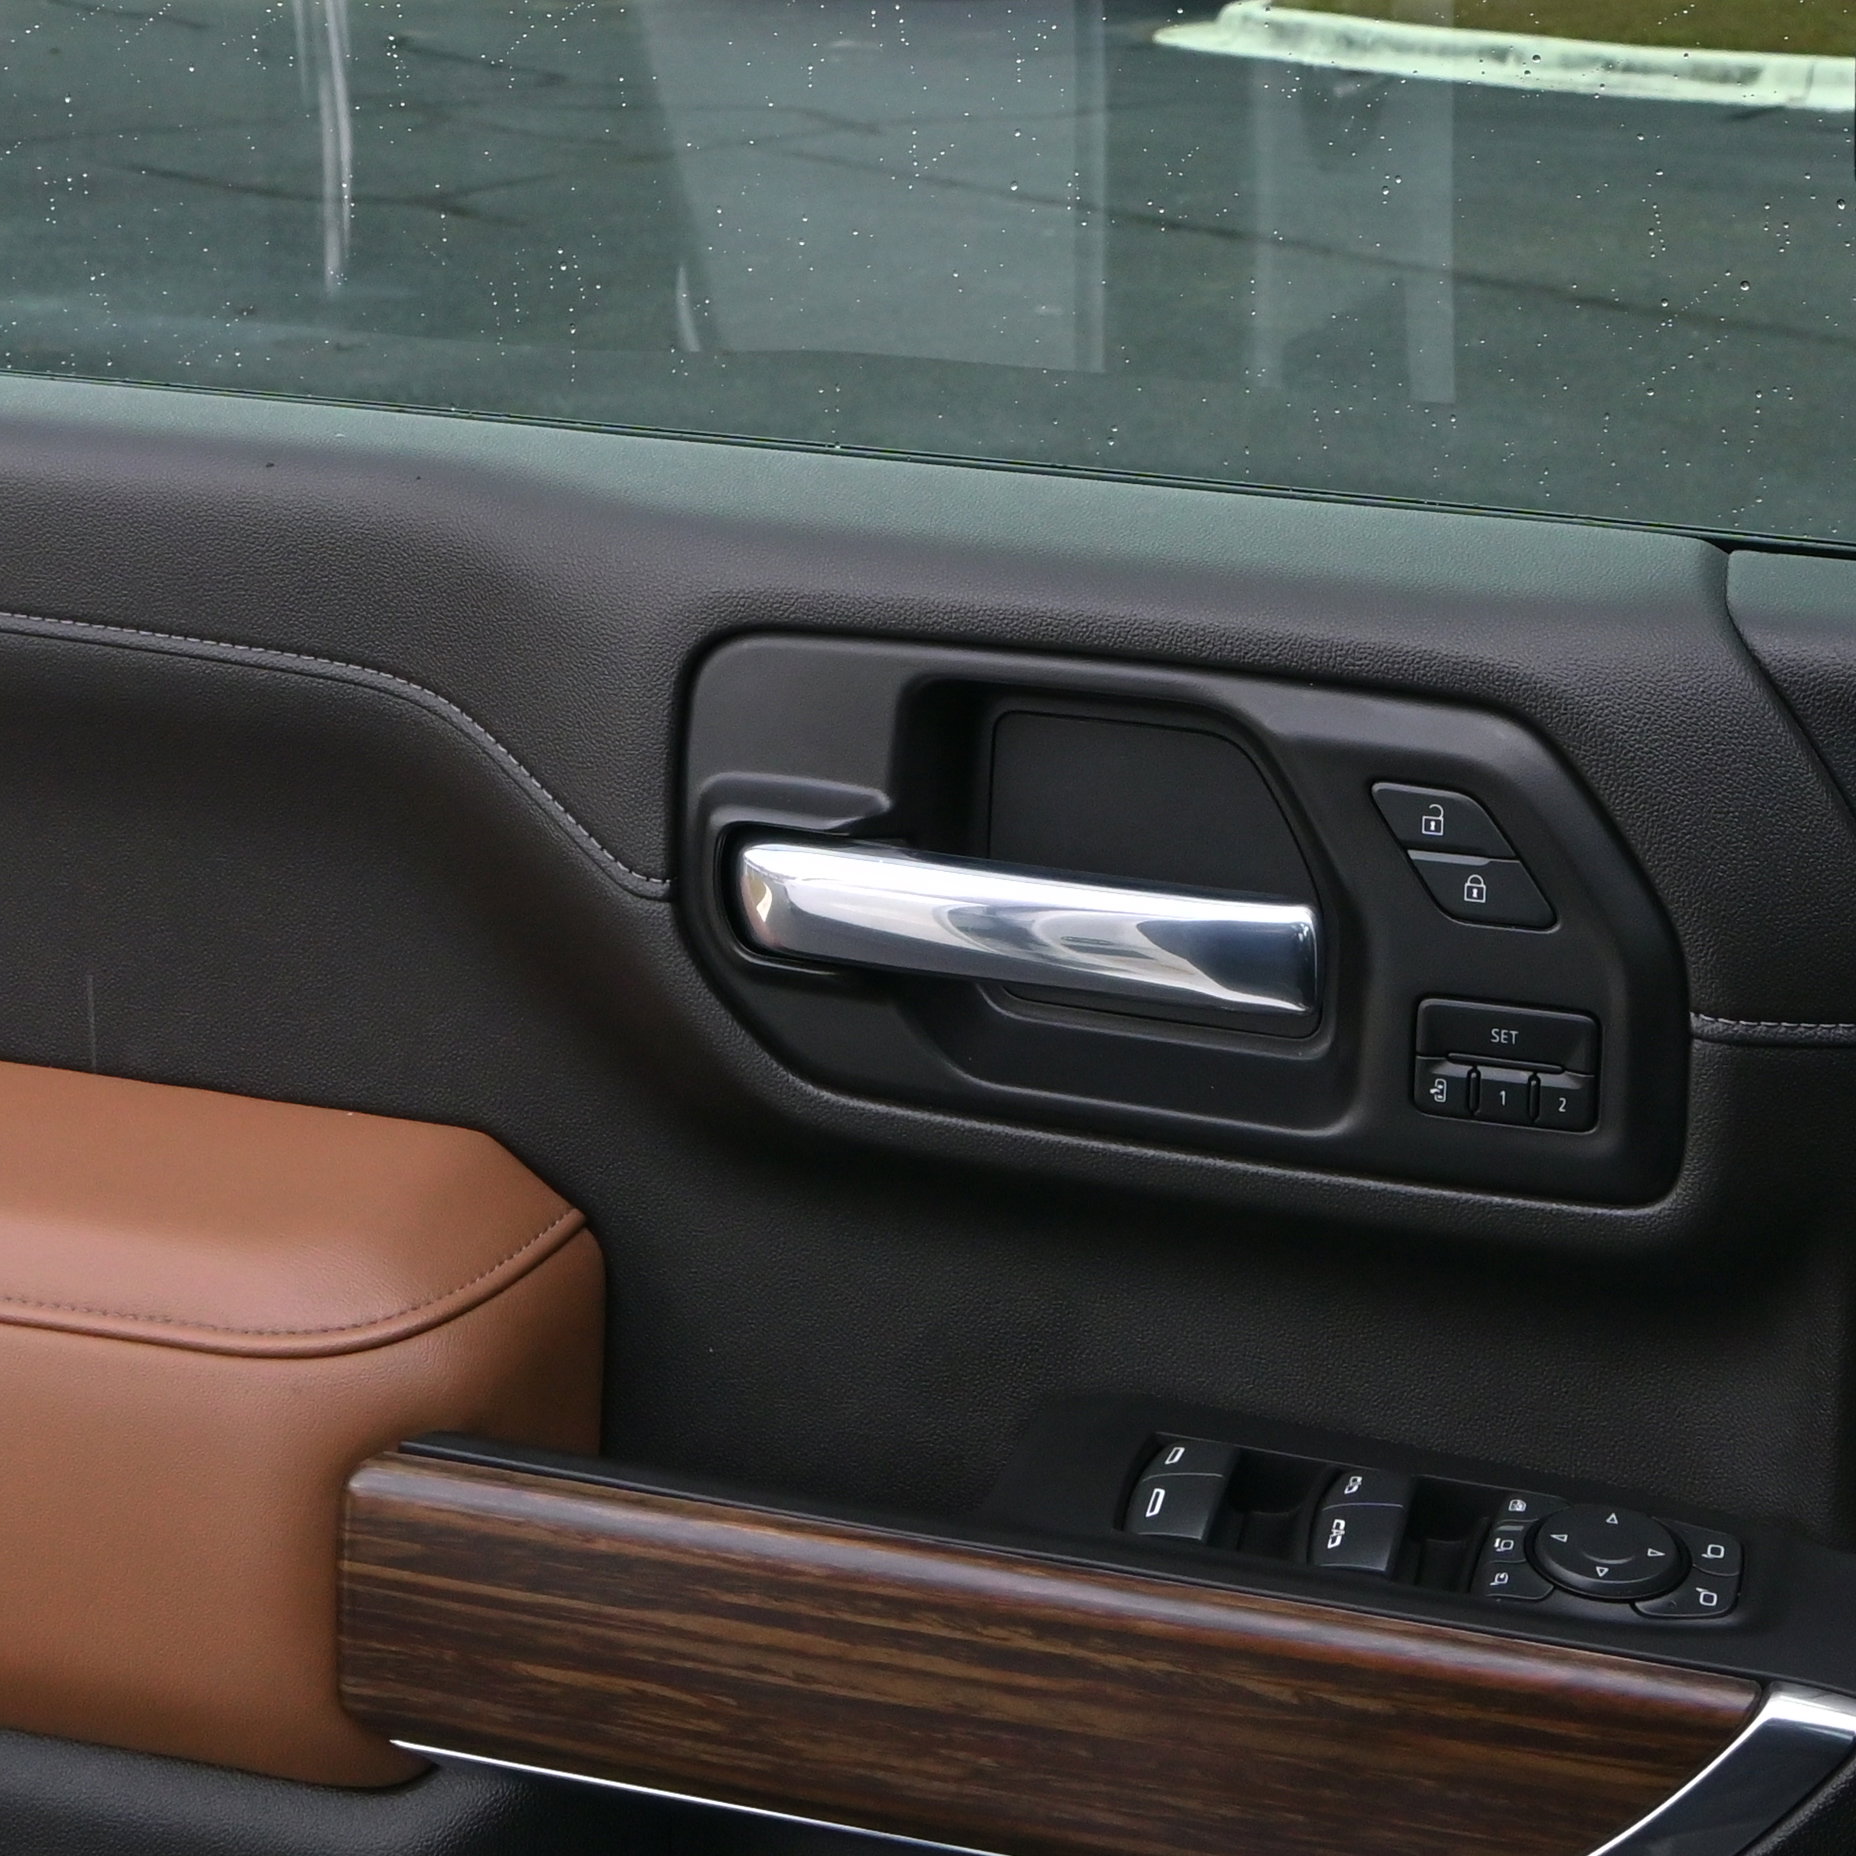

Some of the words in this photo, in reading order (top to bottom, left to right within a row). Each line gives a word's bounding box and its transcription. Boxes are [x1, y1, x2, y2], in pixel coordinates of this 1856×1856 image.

[1491, 1028, 1519, 1045] SET
[1499, 1091, 1506, 1106] 1
[1558, 1098, 1567, 1112] 2
